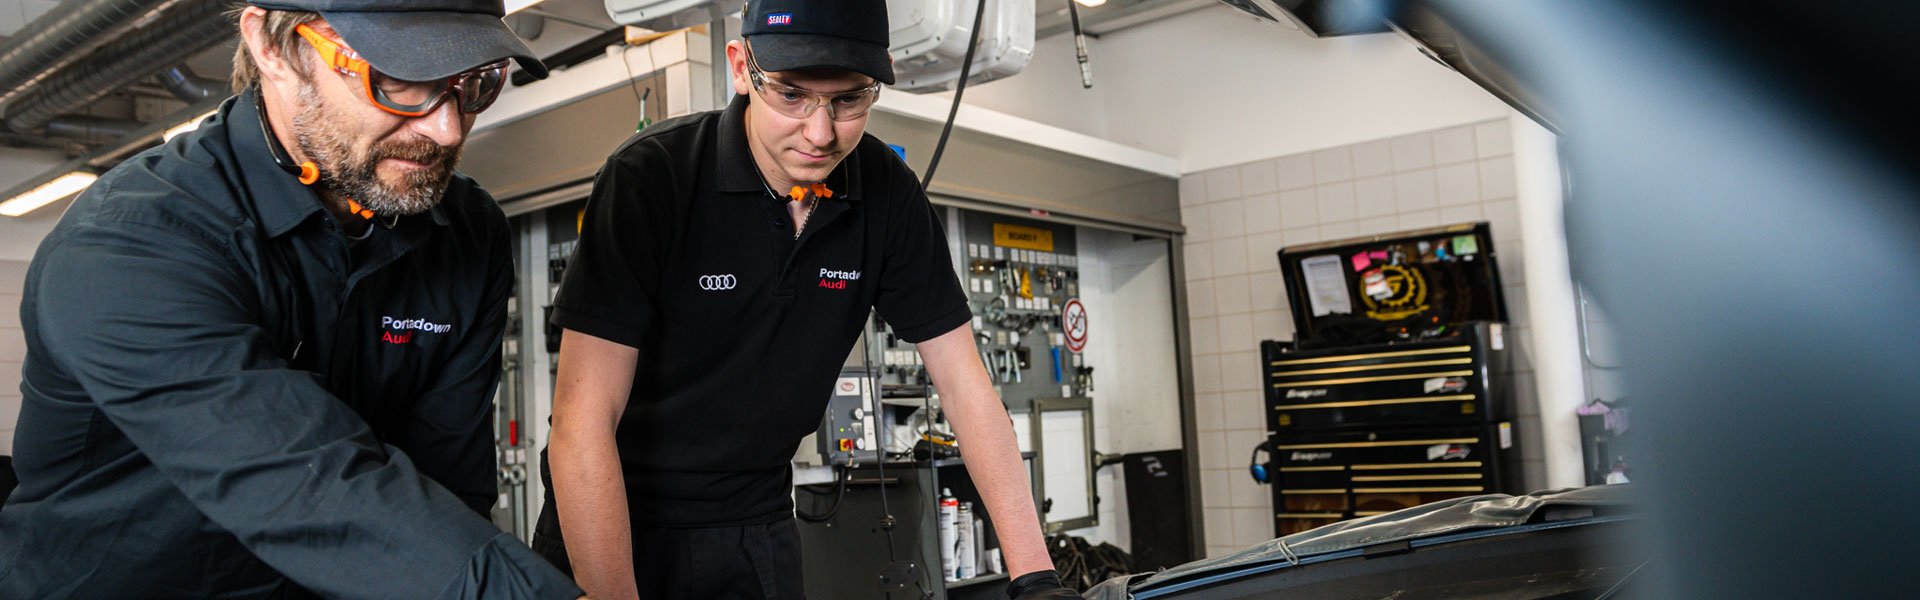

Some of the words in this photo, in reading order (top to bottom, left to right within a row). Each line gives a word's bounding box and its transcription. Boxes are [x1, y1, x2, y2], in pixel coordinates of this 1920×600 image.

[769, 15, 791, 24] SEALEY
[819, 279, 846, 289] Audi
[382, 316, 451, 333] Portadown
